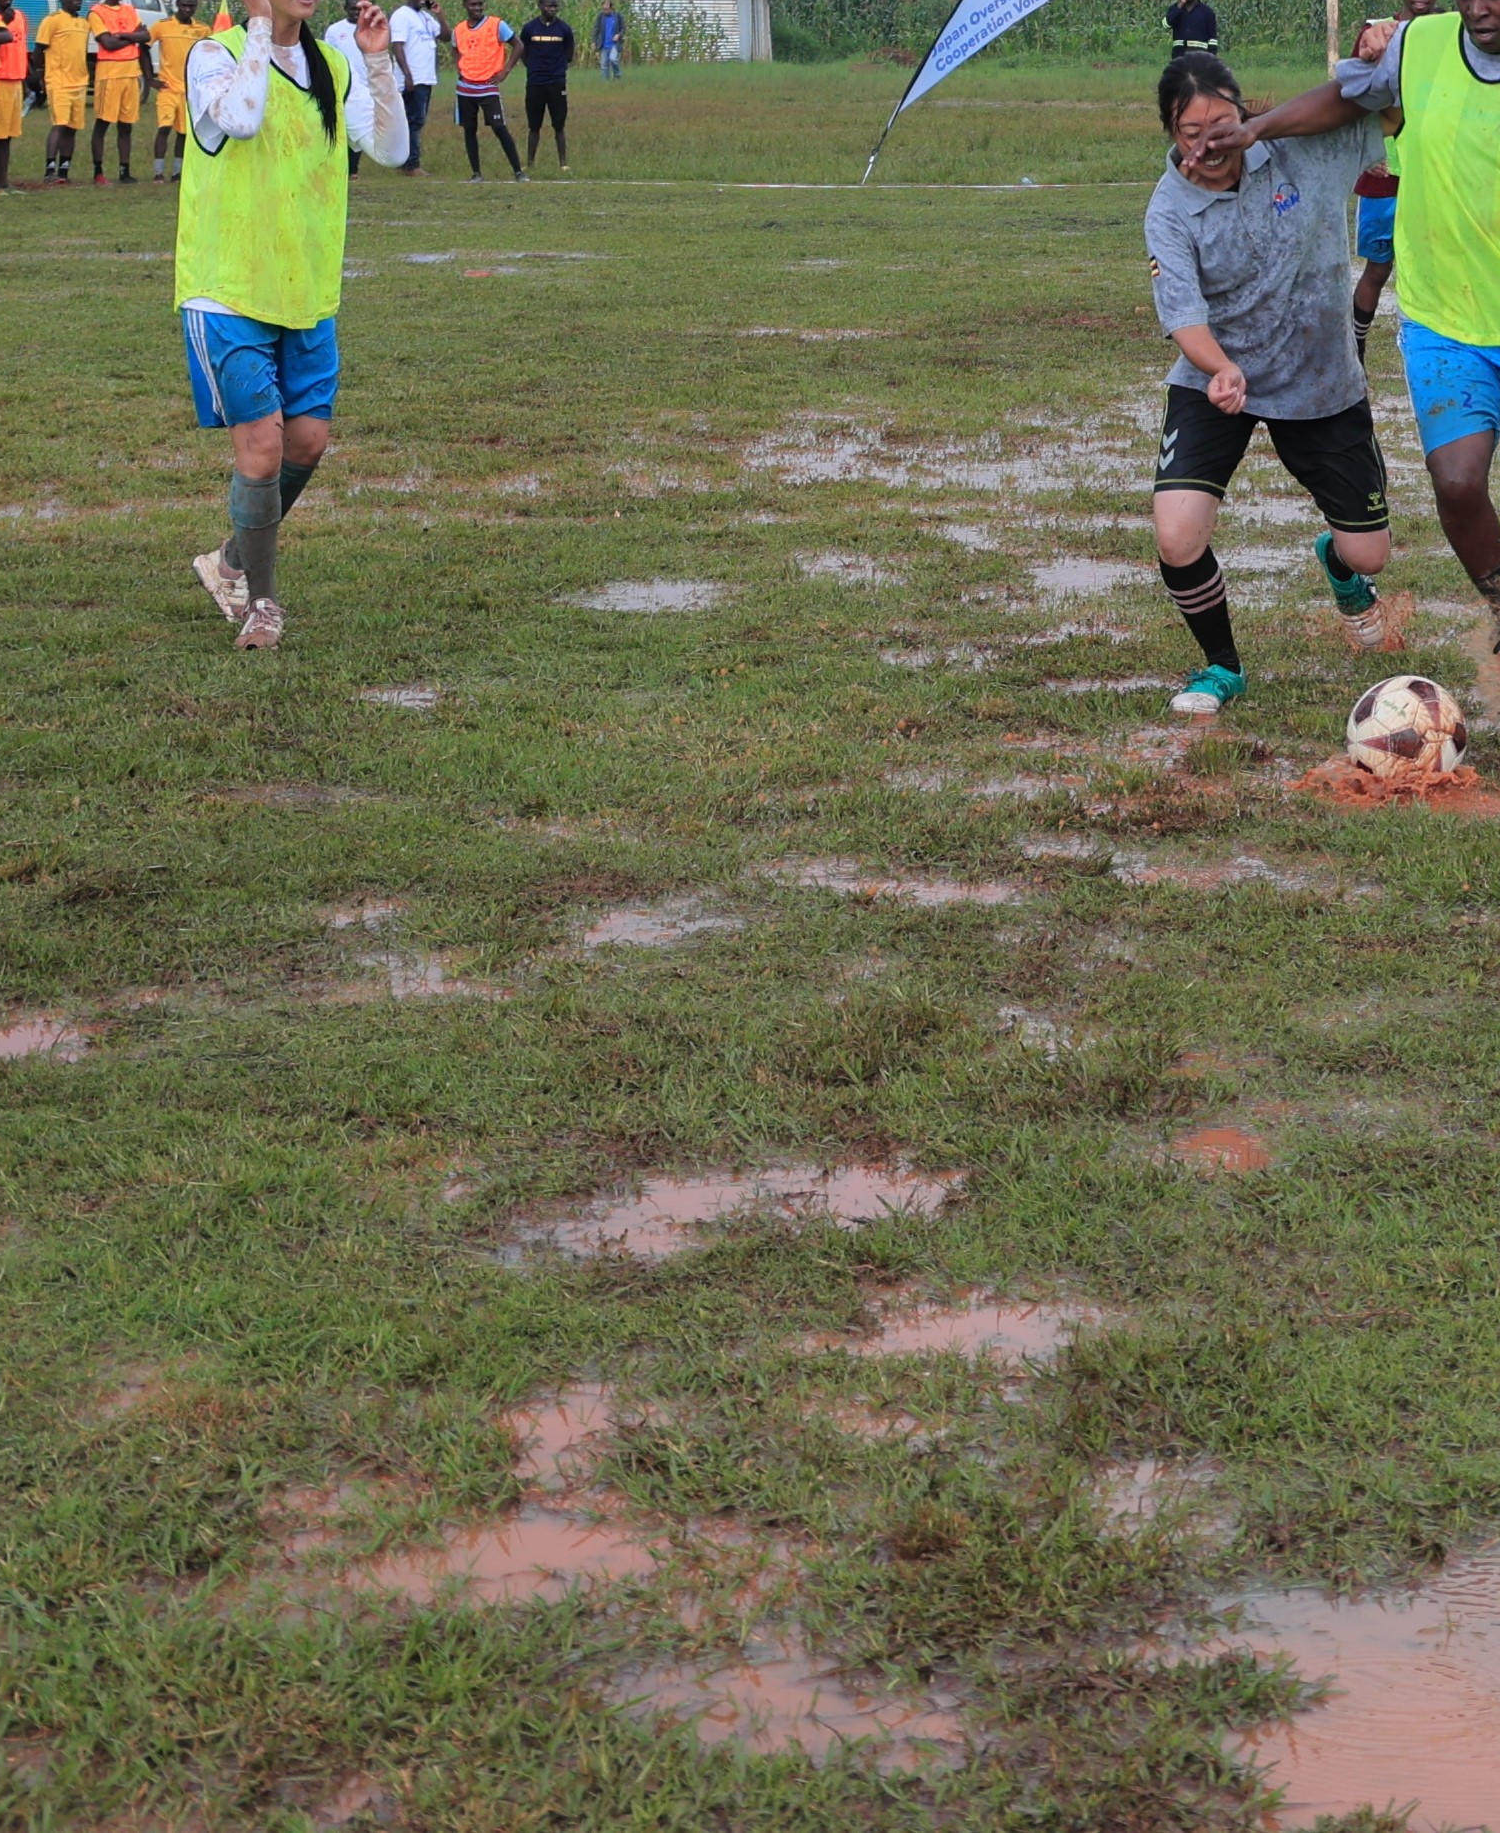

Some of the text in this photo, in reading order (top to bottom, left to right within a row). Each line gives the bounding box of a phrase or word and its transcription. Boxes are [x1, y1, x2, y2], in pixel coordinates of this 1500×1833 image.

[932, 24, 968, 58] Japan
[935, 9, 1013, 72] Cooperation
[1460, 390, 1473, 409] 2
